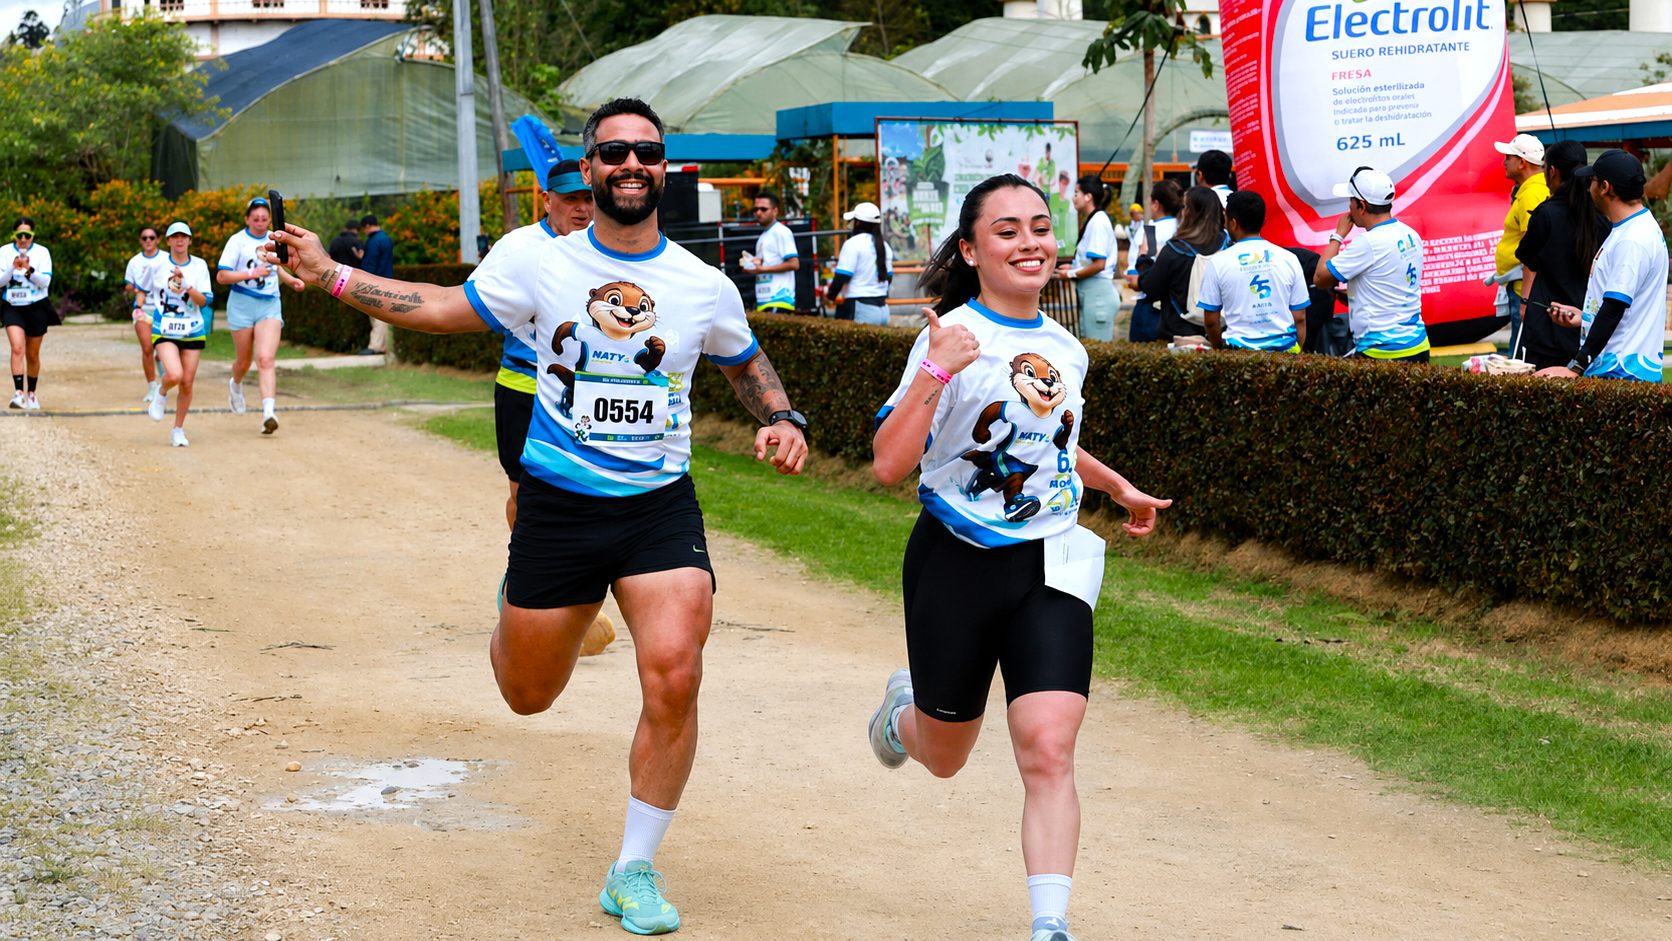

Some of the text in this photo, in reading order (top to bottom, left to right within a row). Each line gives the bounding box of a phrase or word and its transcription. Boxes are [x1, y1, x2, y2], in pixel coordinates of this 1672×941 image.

[1305, 0, 1490, 42] Electrolit
[1331, 42, 1470, 60] SUERO REHIDRATANTE
[1331, 69, 1372, 80] FRESA
[1332, 81, 1425, 96] Solución esterilizada
[1333, 93, 1415, 106] de electrolitos orales
[1369, 105, 1387, 114] para
[1341, 117, 1363, 125] tratar
[1365, 115, 1373, 123] la
[1375, 111, 1432, 122] deshidratación
[1336, 132, 1406, 151] 625 mL
[592, 350, 625, 362] NATY
[594, 397, 654, 424] 0554
[1018, 431, 1047, 442] NATY
